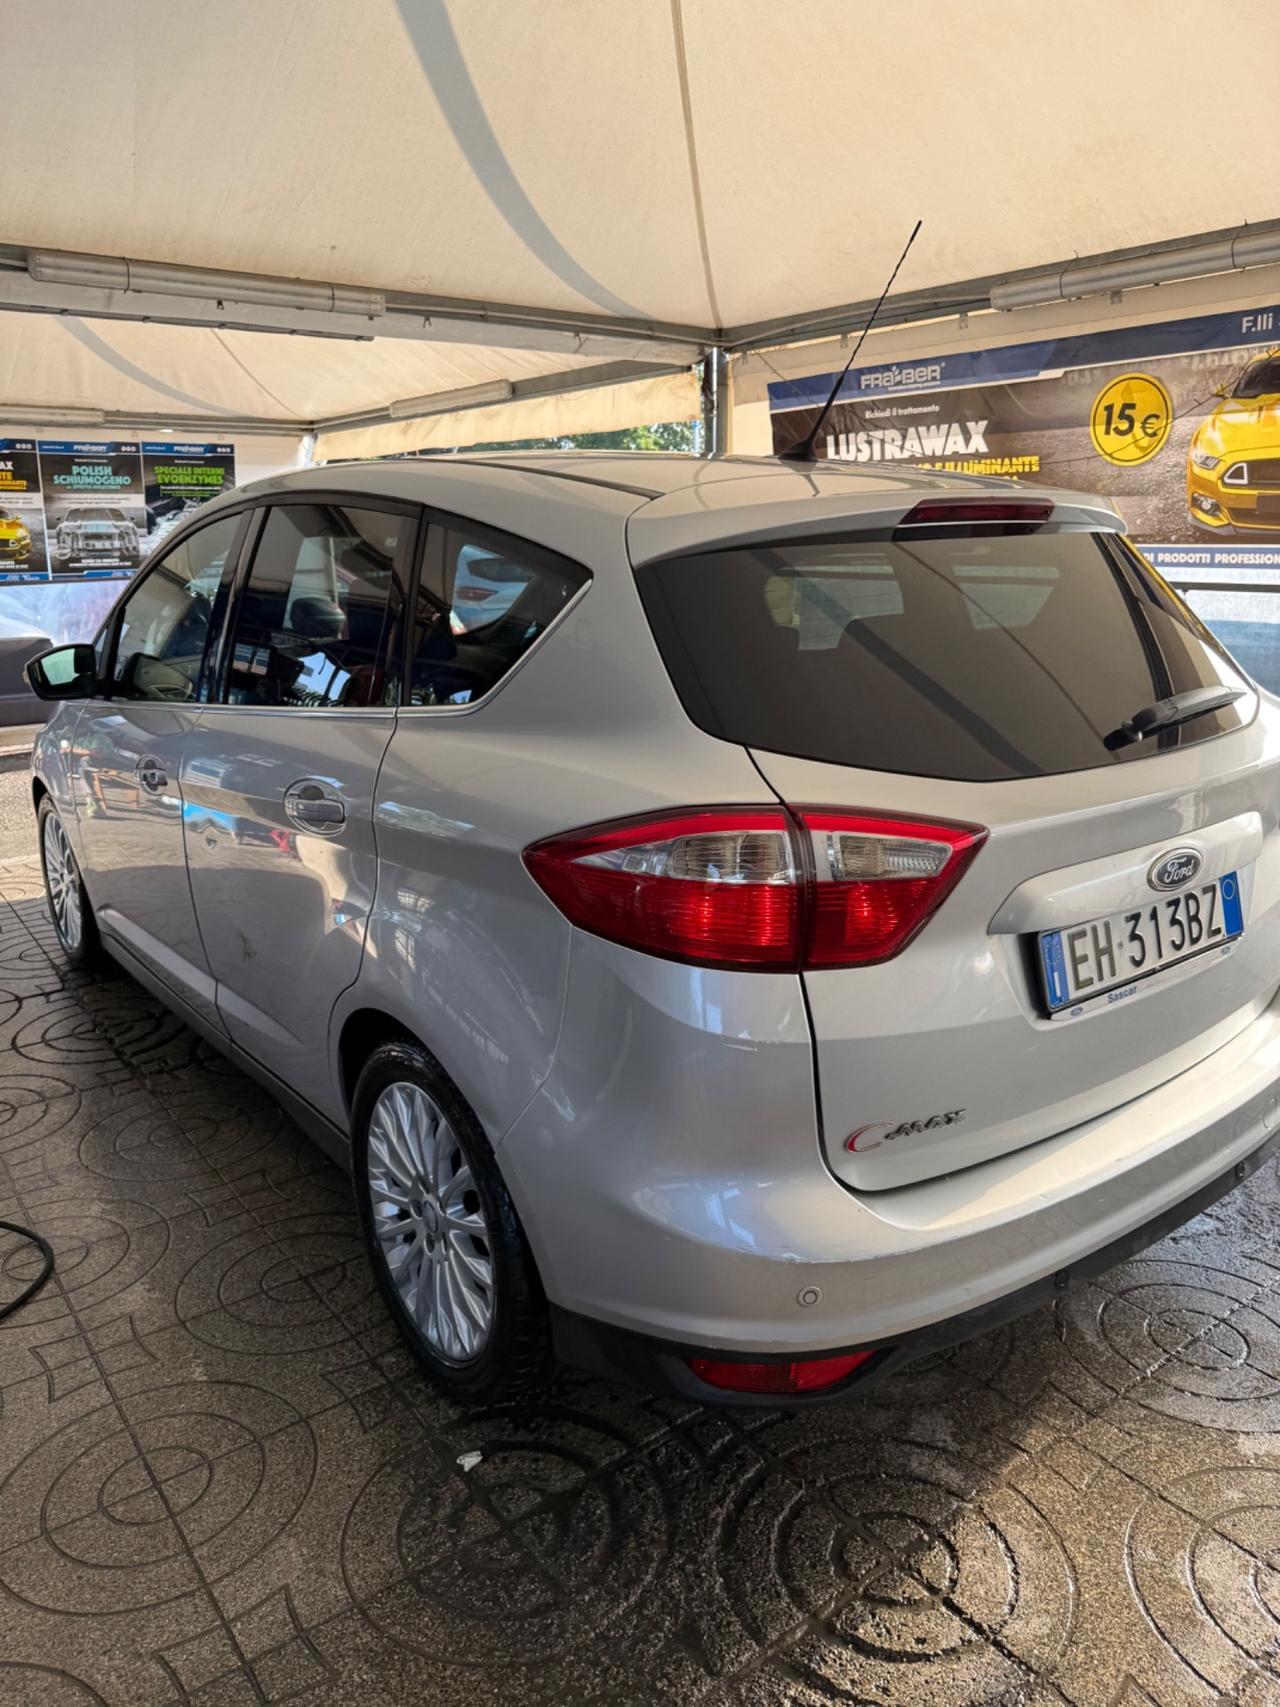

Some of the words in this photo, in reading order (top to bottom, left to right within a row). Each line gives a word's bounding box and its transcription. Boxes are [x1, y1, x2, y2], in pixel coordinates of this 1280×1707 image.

[865, 407, 891, 419] Richiedi
[898, 403, 940, 416] trattamento
[1103, 403, 1137, 436] 15
[1140, 414, 1161, 438] €
[826, 420, 989, 462] LUSTRAWAX
[72, 466, 112, 476] POLISH
[53, 475, 131, 485] SCHIUMOGENO
[1158, 552, 1211, 563] PRODOTTI
[1165, 858, 1195, 883] Ford
[1067, 920, 1116, 991] EH
[1125, 883, 1222, 968] 313BZ
[1107, 986, 1137, 1003] Sascar
